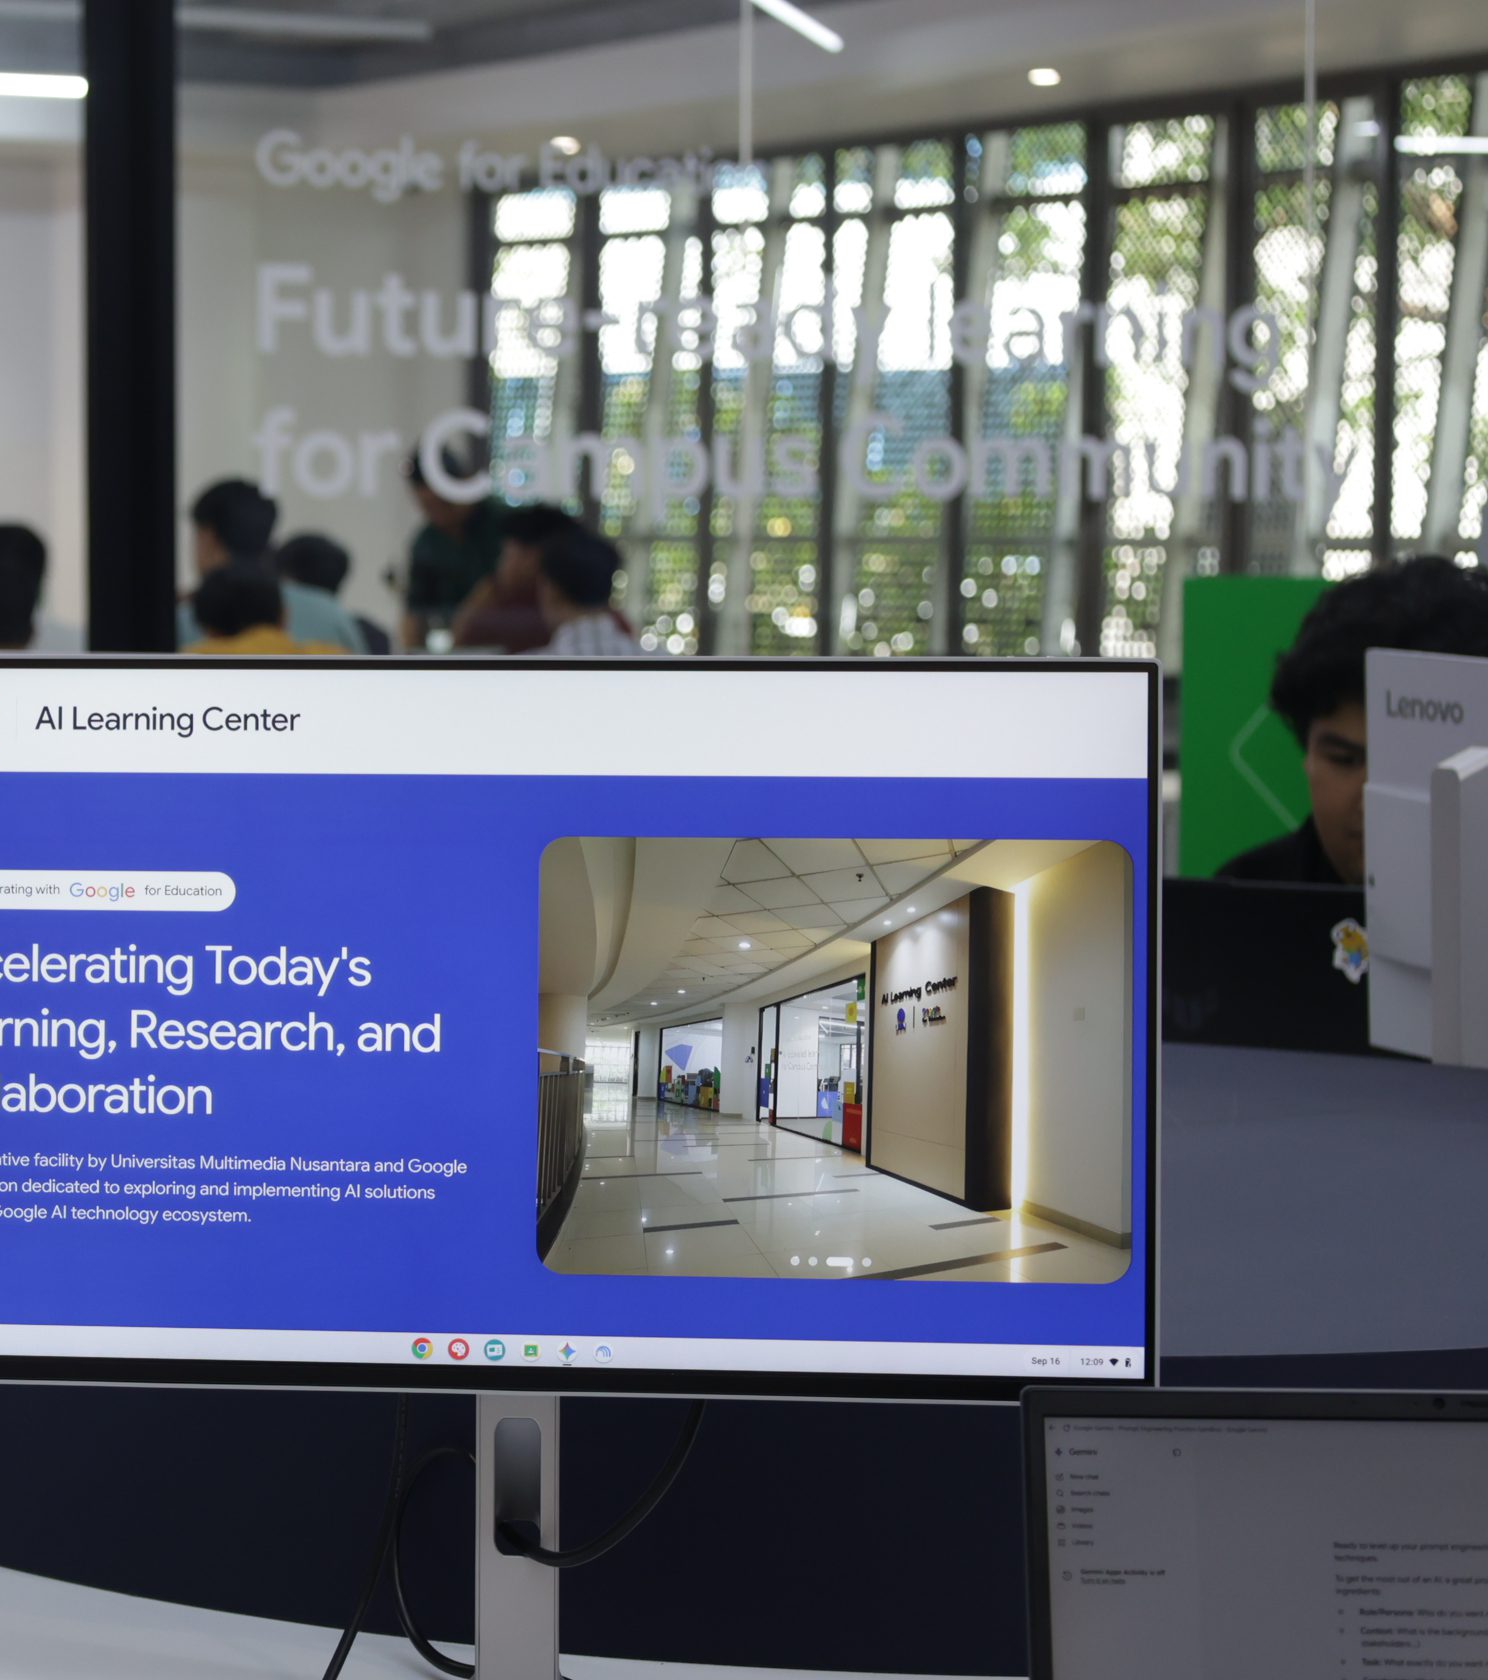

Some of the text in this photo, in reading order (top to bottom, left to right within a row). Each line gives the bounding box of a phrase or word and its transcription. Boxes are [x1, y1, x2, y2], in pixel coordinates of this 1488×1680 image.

[256, 129, 443, 204] Google
[459, 138, 524, 192] for
[254, 408, 404, 500] for
[418, 407, 819, 524] Campus
[1386, 688, 1464, 724] Lenovo
[35, 706, 301, 738] AI Learning Center
[35, 883, 61, 895] with
[69, 882, 136, 902] Google
[144, 885, 162, 896] for
[165, 885, 223, 897] Education
[206, 945, 372, 997] Today's
[131, 1009, 346, 1057] Research,
[357, 1014, 441, 1053] and
[33, 1152, 84, 1171] facility
[88, 1154, 106, 1171] by
[111, 1154, 195, 1169] Universitas
[200, 1155, 286, 1171] Multimedia
[290, 1157, 370, 1172] Nusantara
[374, 1158, 404, 1173] and
[408, 1158, 467, 1178] Google
[22, 1178, 99, 1194] dedicated
[104, 1181, 120, 1194] to
[124, 1181, 196, 1199] exploring
[200, 1182, 229, 1197] and
[233, 1182, 341, 1202] implementing
[345, 1184, 360, 1199] AI
[364, 1184, 435, 1200] solutions
[51, 1205, 66, 1219] AI
[71, 1205, 158, 1225] technology
[162, 1208, 251, 1225] ecosystem.
[1031, 1357, 1060, 1366] Sep 16
[1080, 1358, 1104, 1366] 12:09
